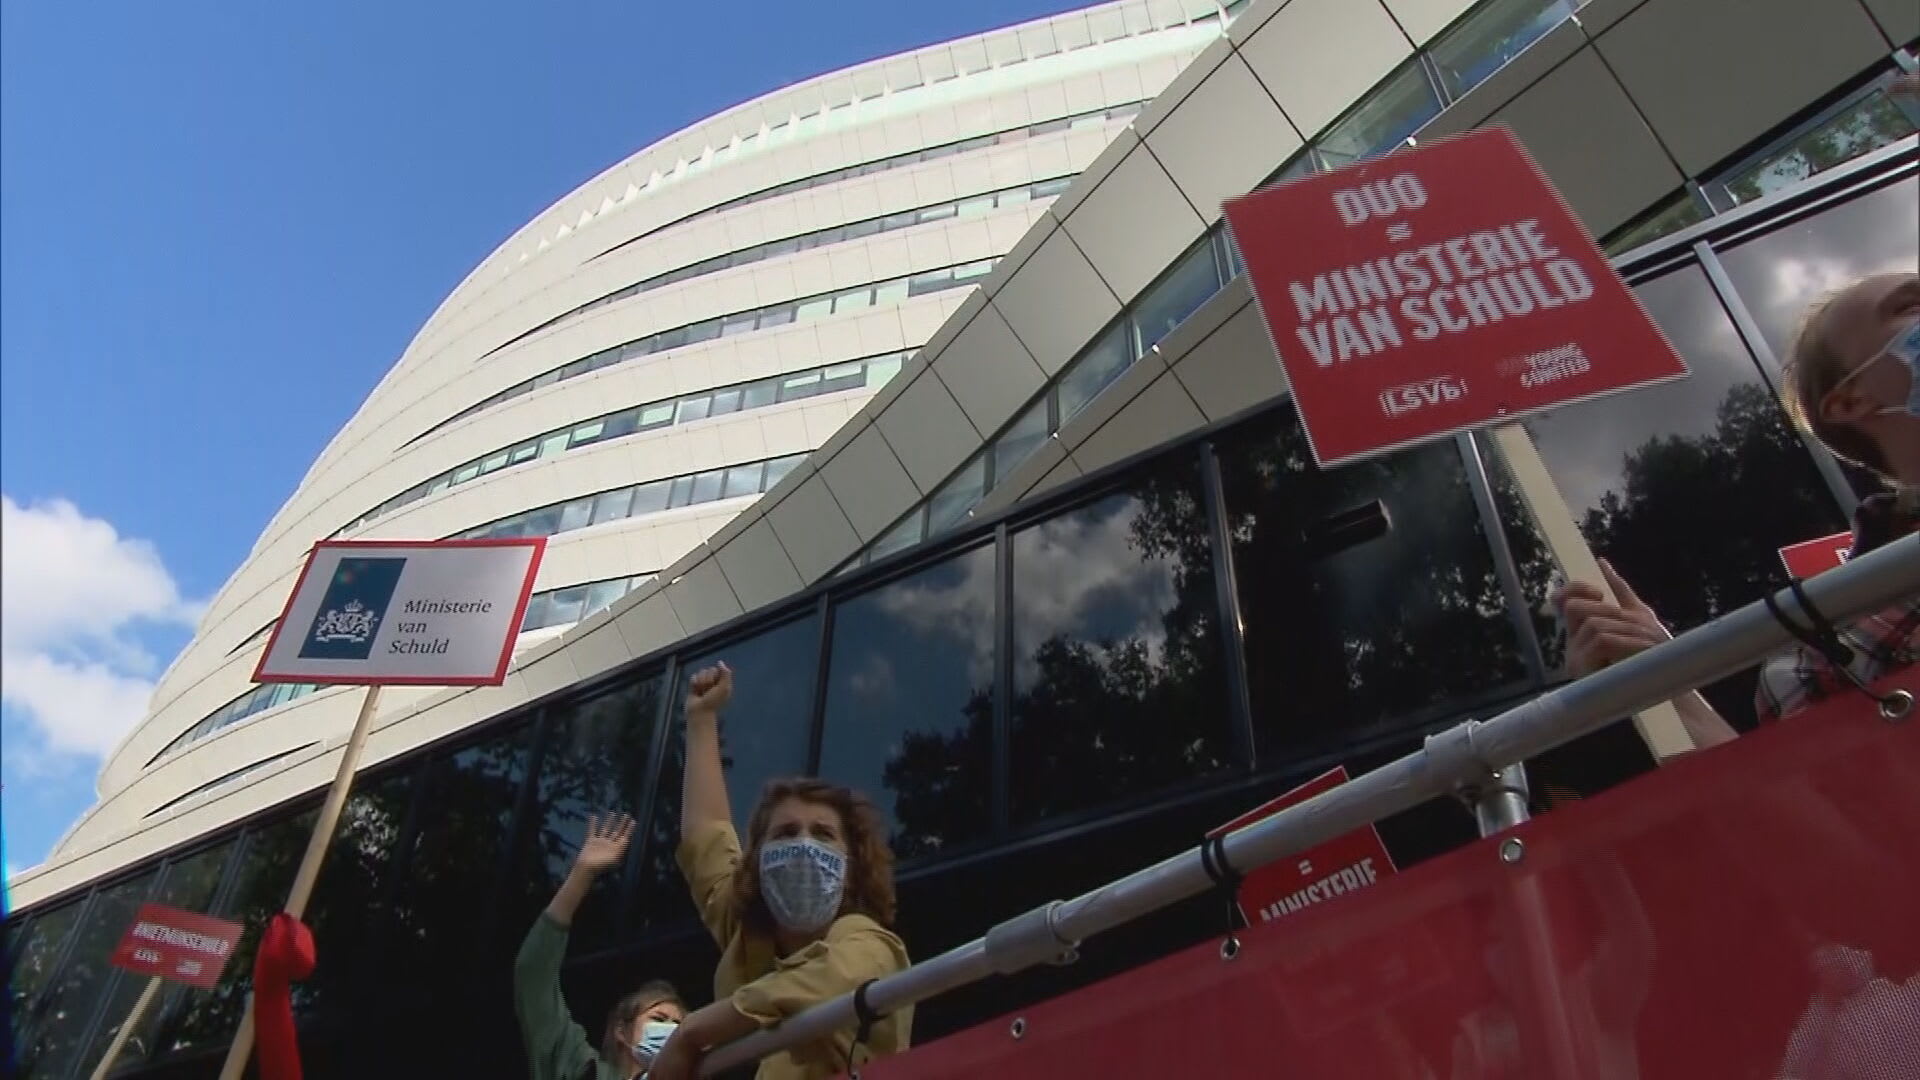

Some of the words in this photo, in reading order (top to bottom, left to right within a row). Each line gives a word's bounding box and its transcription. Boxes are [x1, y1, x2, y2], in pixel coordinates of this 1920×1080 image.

[1332, 173, 1428, 226] DUO
[1288, 218, 1560, 321] MINISTERIE
[1296, 304, 1403, 367] VAN
[1400, 257, 1595, 341] SCHULD
[1525, 342, 1583, 370] YOUNG
[404, 599, 492, 614] Ministerie
[397, 621, 427, 634] van
[388, 639, 450, 655] Schuld
